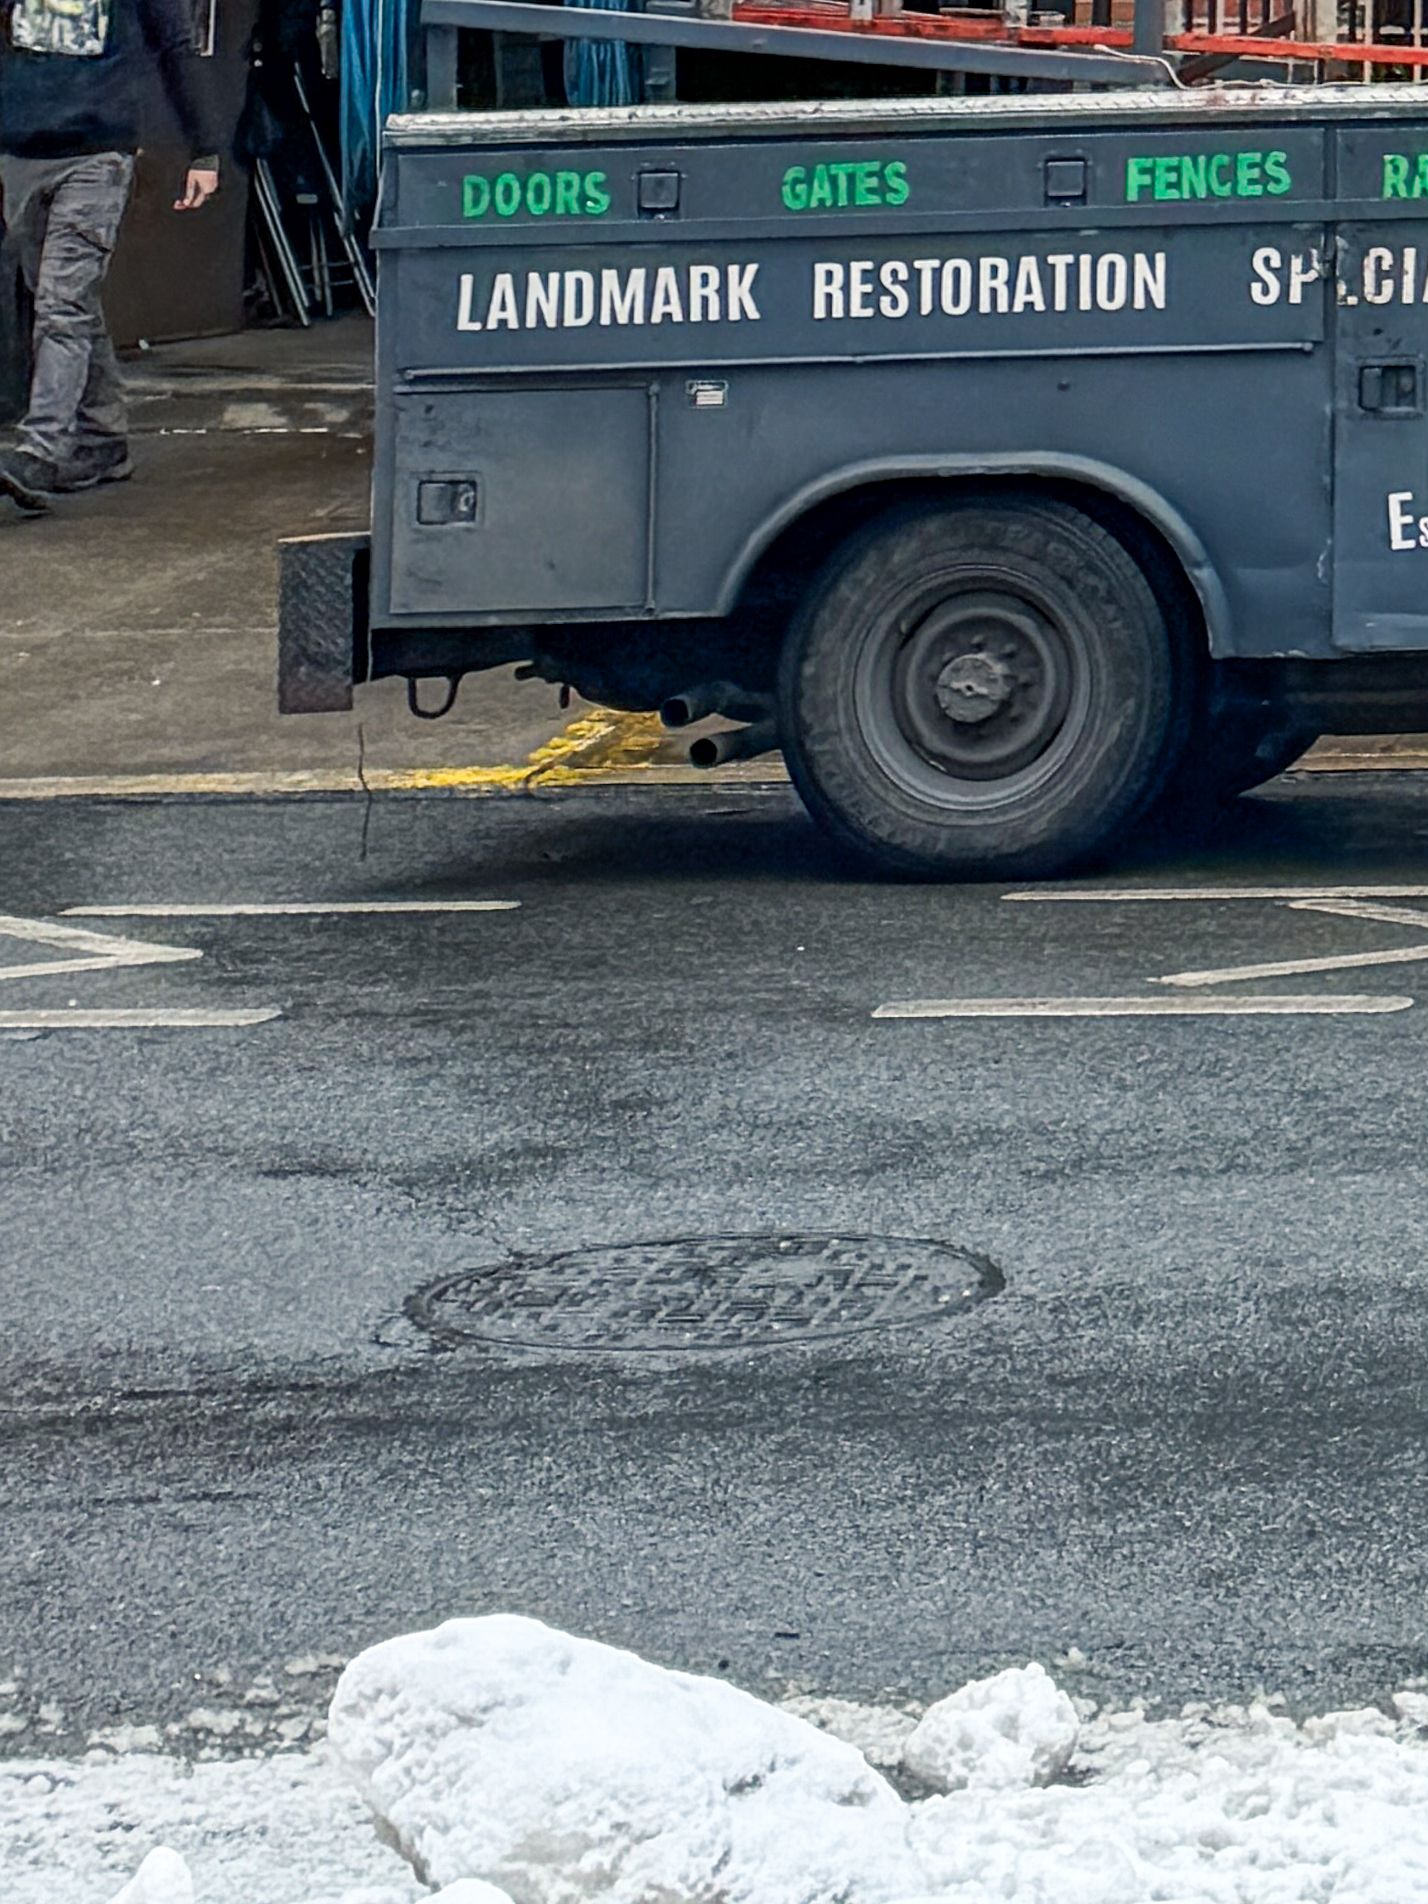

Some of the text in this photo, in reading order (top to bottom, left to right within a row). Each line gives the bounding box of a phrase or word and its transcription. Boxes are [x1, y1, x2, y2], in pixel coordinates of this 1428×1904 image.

[463, 171, 610, 217] DOORS
[782, 161, 910, 210] GATES
[1126, 152, 1291, 201] FENCES
[457, 264, 760, 331] LANDMARK
[813, 251, 1166, 320] RESTORATION
